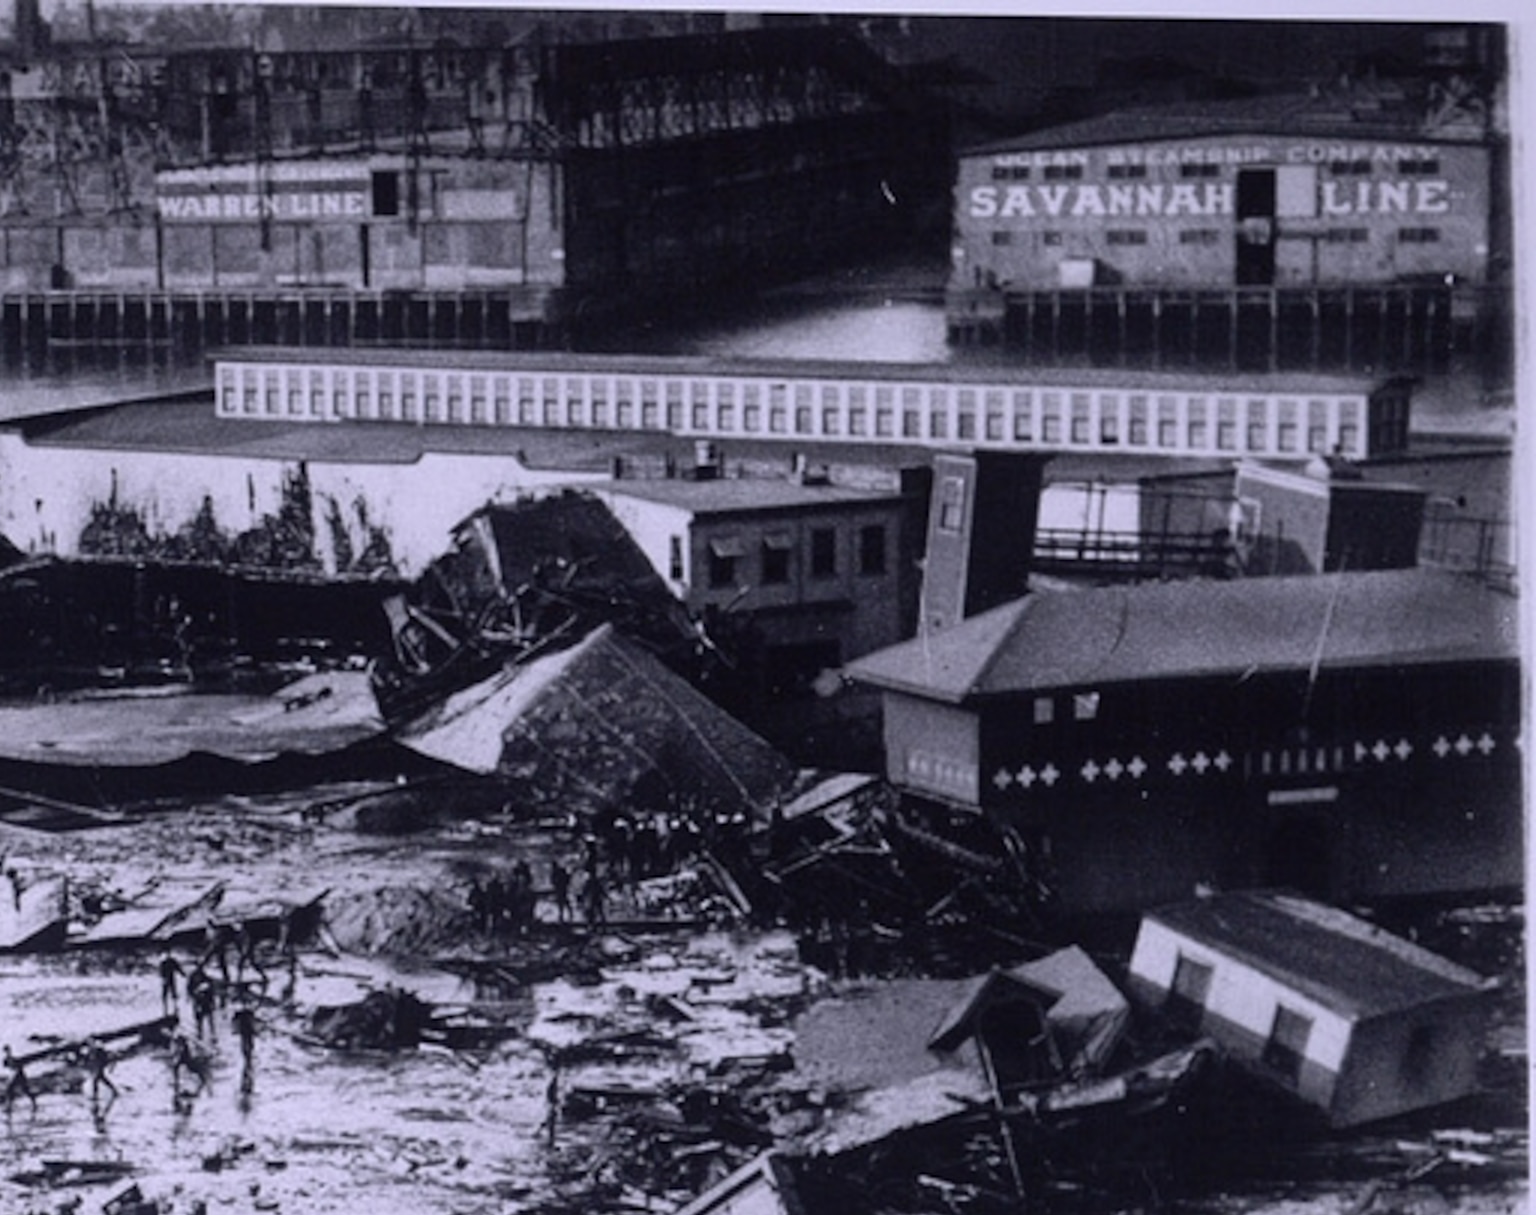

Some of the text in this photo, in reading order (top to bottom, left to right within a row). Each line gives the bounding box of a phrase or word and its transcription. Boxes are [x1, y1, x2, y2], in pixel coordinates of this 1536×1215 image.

[1286, 143, 1439, 163] COMPANY
[157, 192, 365, 218] WARREN LINE
[970, 179, 1450, 217] SAVANNAH LINE
